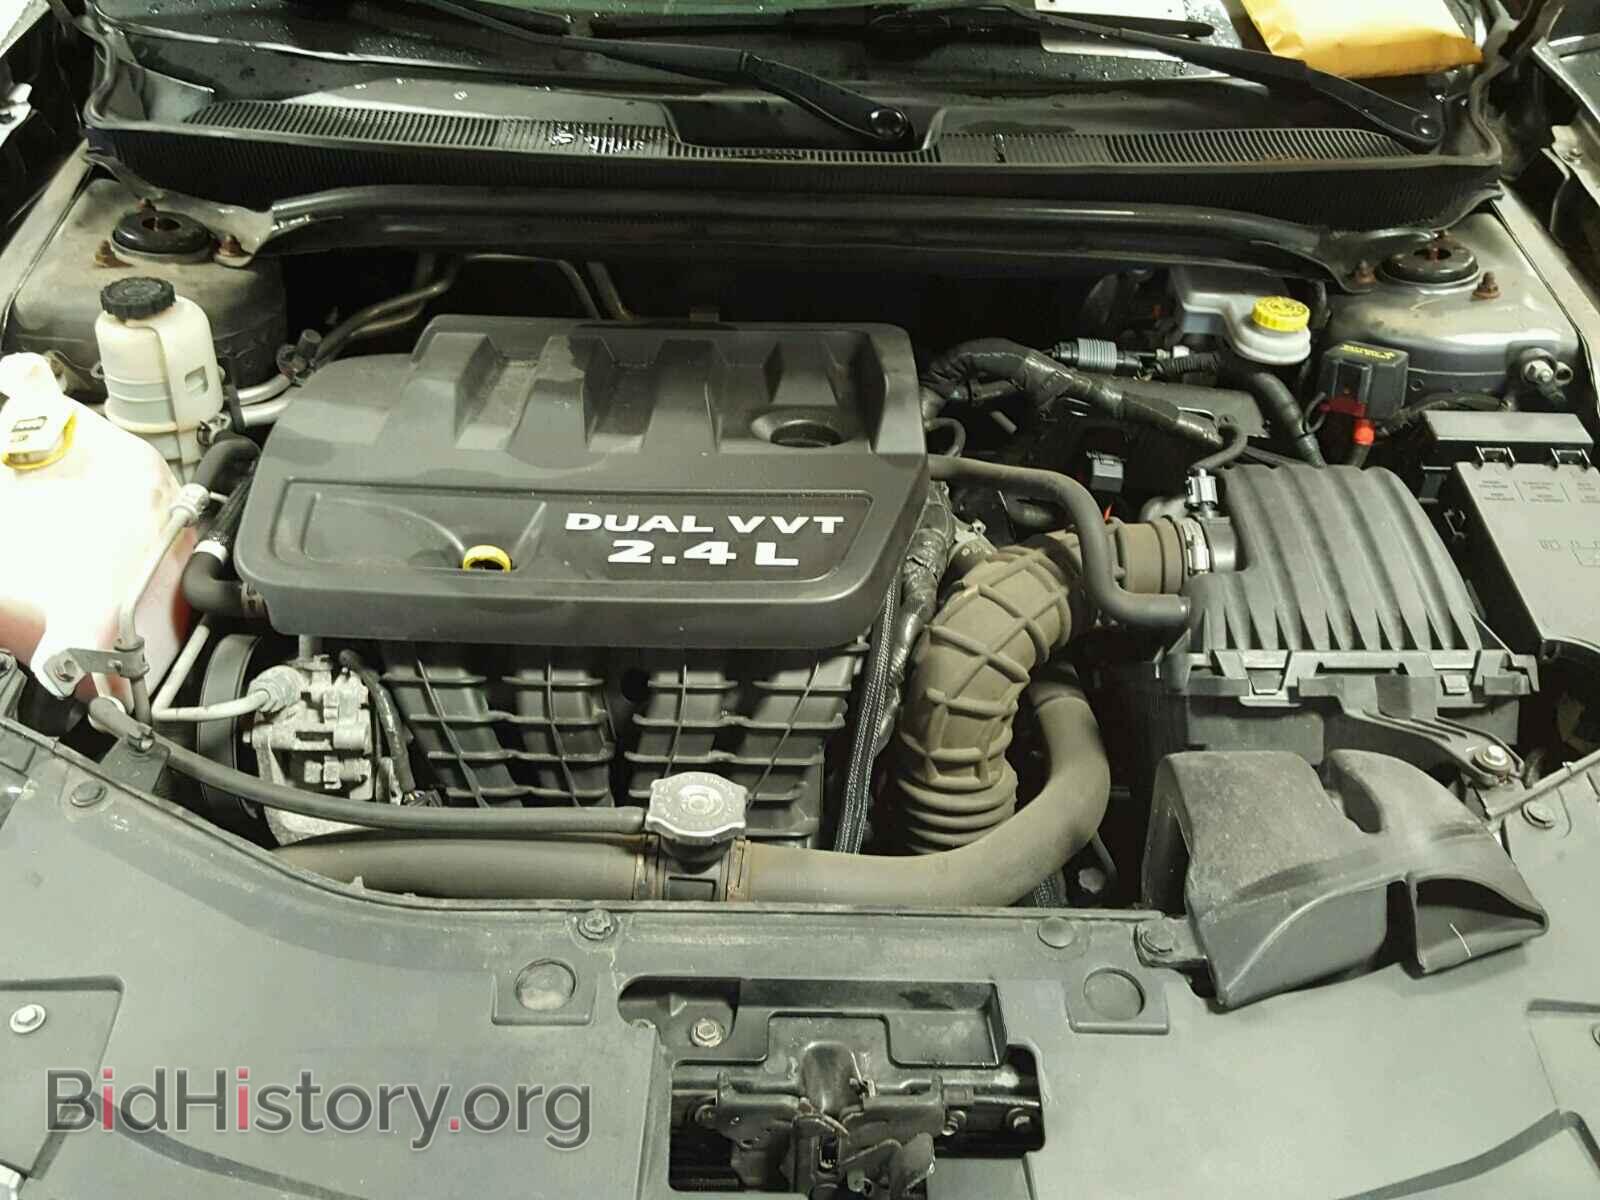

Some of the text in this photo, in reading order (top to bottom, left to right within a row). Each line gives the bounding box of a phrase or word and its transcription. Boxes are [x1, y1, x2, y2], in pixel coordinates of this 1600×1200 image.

[565, 512, 844, 534] DUAL VVT
[607, 539, 799, 566] 2.4 L
